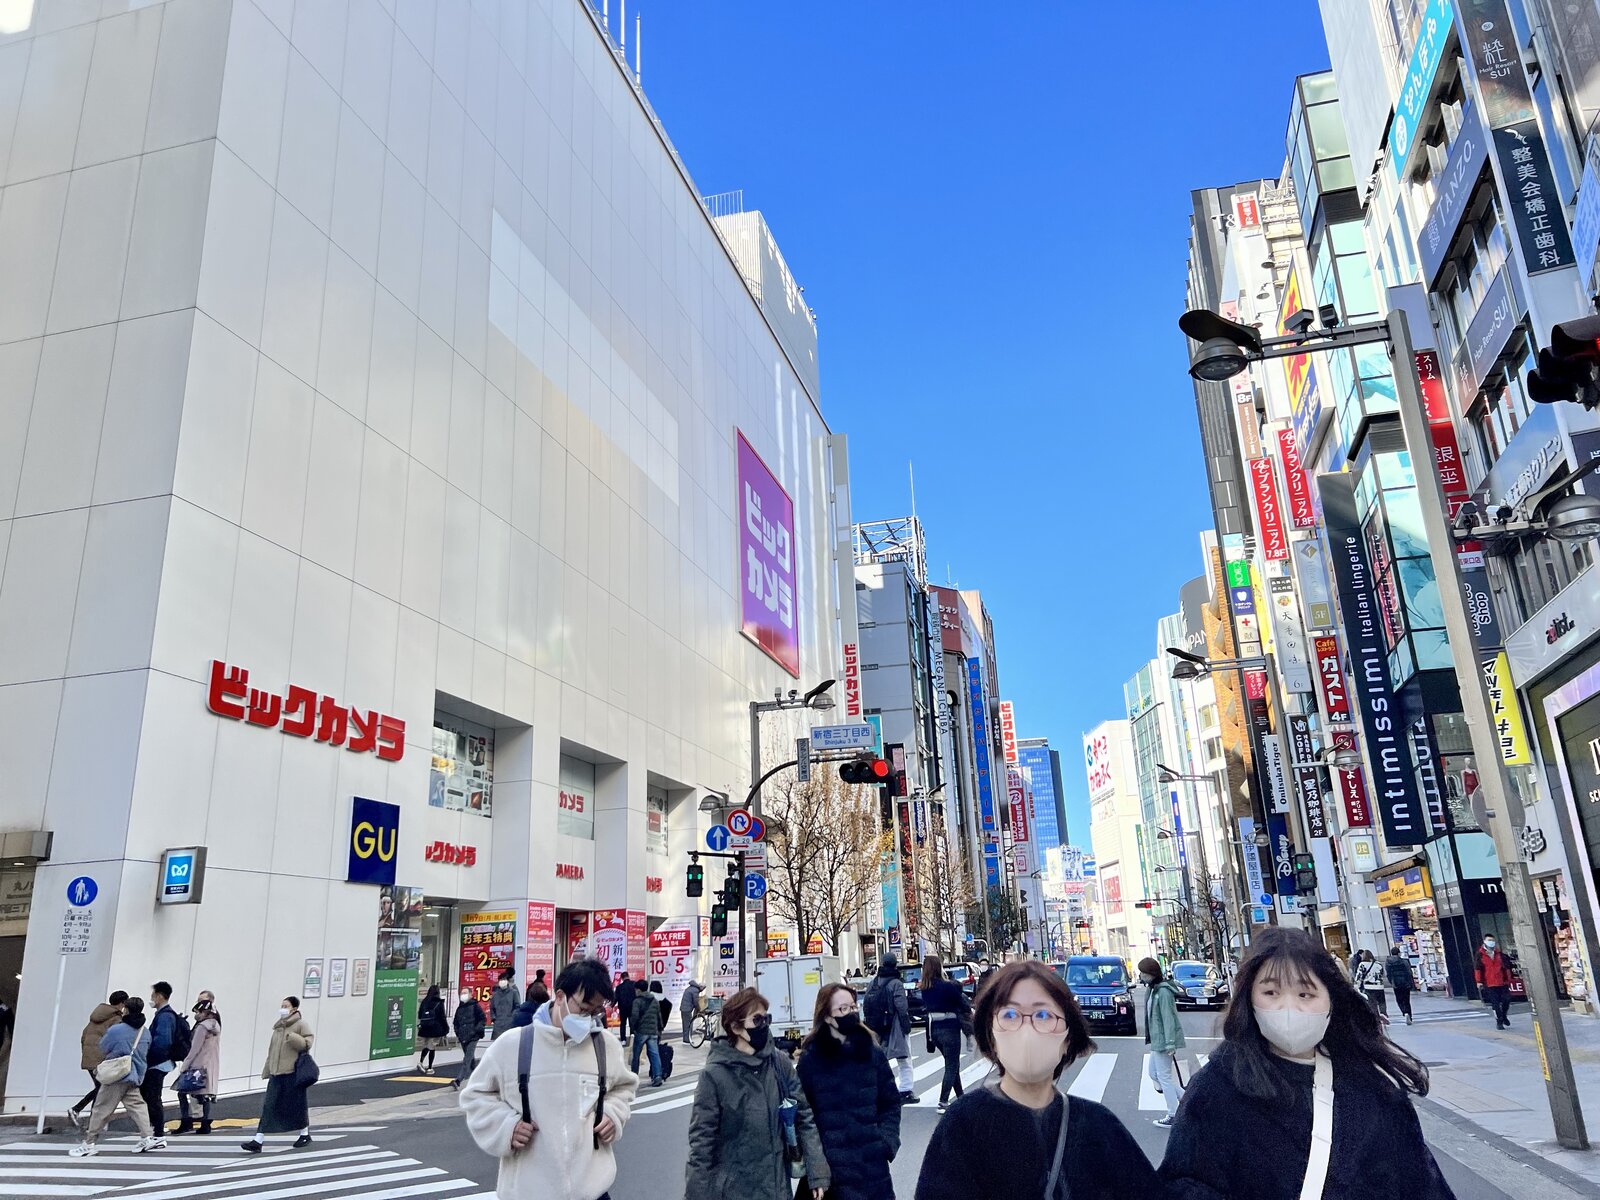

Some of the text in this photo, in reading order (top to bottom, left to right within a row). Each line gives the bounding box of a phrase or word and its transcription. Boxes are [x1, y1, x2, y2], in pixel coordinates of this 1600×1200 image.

[1479, 60, 1517, 74] Hair Resort
[1490, 68, 1511, 79] SUI
[1511, 146, 1561, 267] 整美会矯正歯科
[1494, 295, 1509, 329] SUI
[1423, 354, 1436, 380] スリム
[1237, 393, 1252, 403] 8F
[1286, 445, 1308, 517] ブランクリニック
[1258, 472, 1281, 550] ブランクリニック
[1295, 517, 1314, 527] 7.8F
[744, 480, 791, 575] ビック
[1265, 549, 1287, 559] 7.8F
[747, 544, 793, 630] カメラ
[1346, 536, 1375, 637] Italian lingerie
[1314, 611, 1326, 620] 5F
[1475, 592, 1492, 625] Shop
[1316, 640, 1336, 648] Café
[935, 651, 948, 735] MEGANE ICHIBA
[1321, 655, 1343, 707] ガスト
[206, 659, 407, 762] ビックカメラ
[1331, 711, 1348, 721] 4F
[1482, 657, 1517, 759] マツモトキヨシ
[813, 727, 870, 740] 新宿三丁目西
[1361, 647, 1411, 831] intimissimi
[1296, 734, 1308, 773] COFFE
[1346, 770, 1359, 799] よしえ
[1303, 779, 1323, 829] 星乃珈琲店
[353, 821, 396, 863] GU
[1313, 829, 1324, 837] 2F
[747, 880, 758, 896] P
[653, 932, 686, 941] TAX FREE
[720, 947, 734, 955] GU
[649, 957, 684, 975] 10 5
